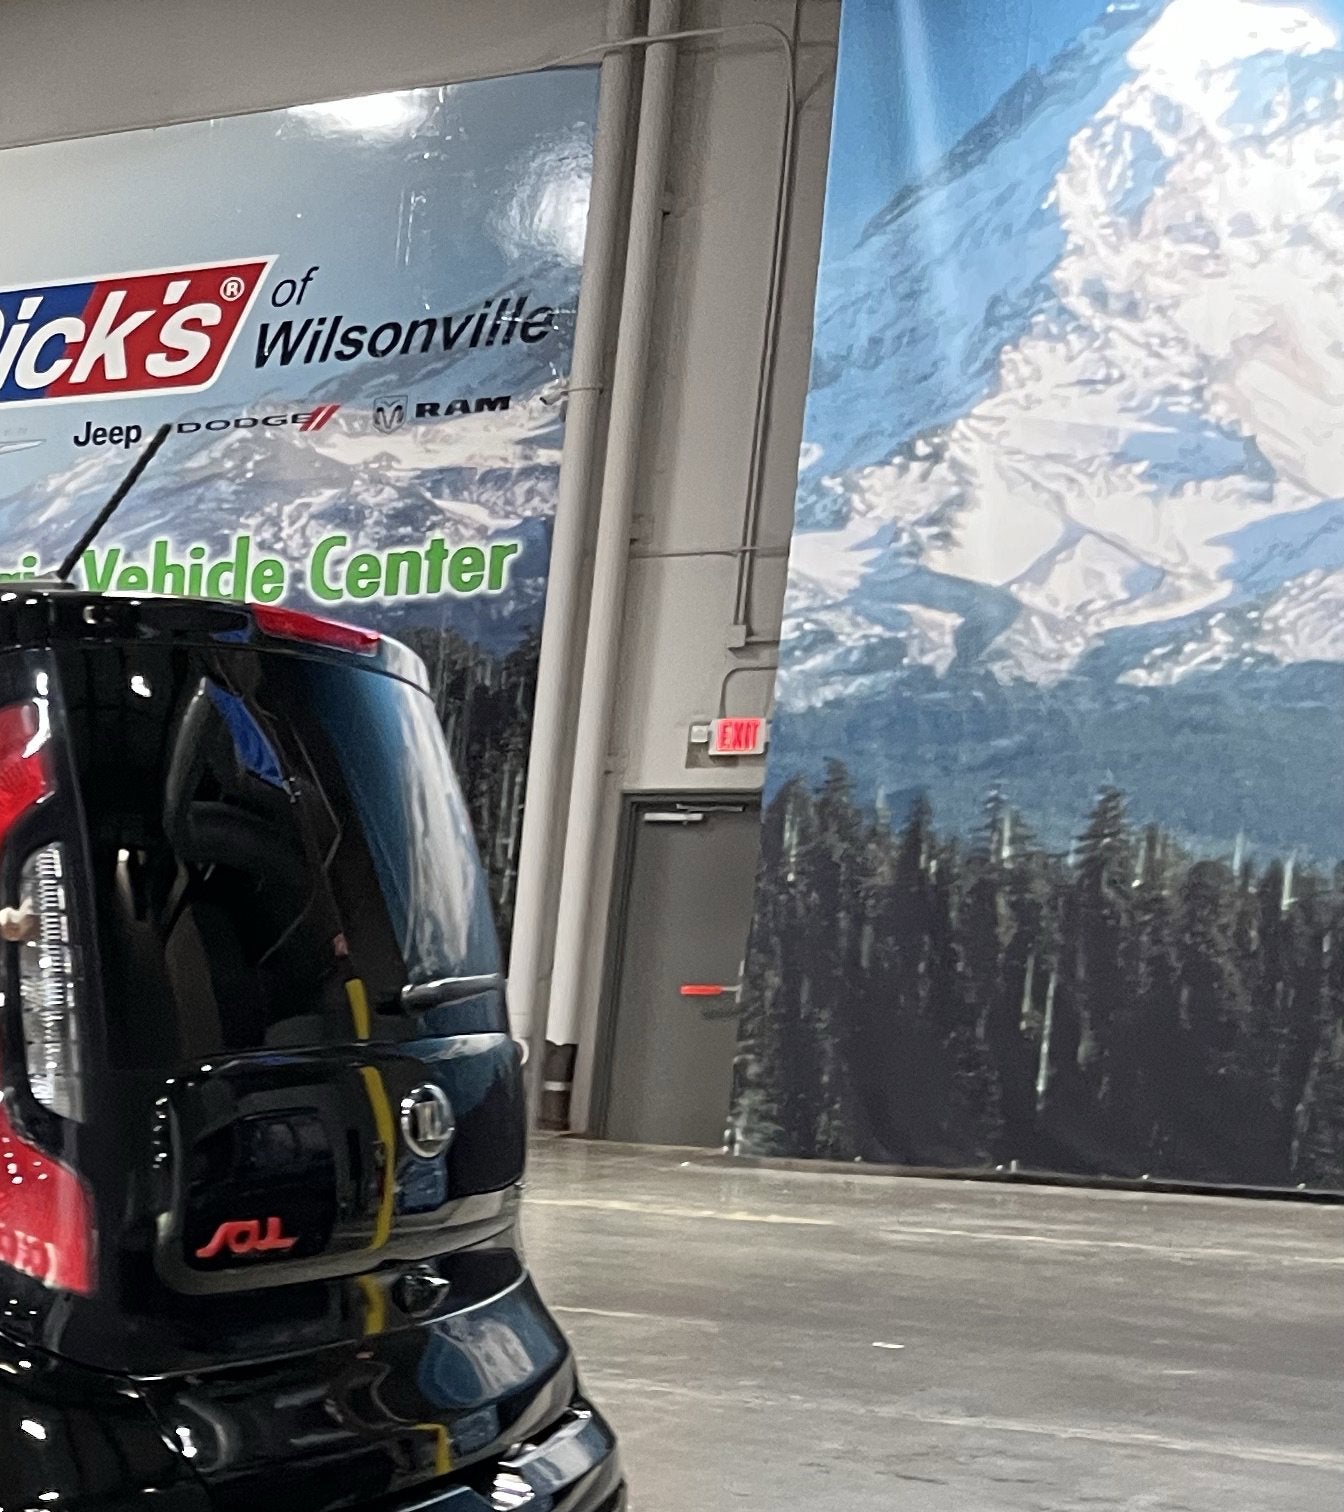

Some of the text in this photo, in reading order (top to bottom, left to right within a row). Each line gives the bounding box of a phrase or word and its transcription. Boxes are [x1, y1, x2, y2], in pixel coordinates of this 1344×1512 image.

[271, 266, 319, 308] of
[255, 296, 554, 368] Wilsonville
[415, 396, 512, 418] RAM
[73, 421, 142, 449] Jeep
[177, 412, 311, 434] DODGE
[83, 536, 285, 603] Vehicle
[311, 536, 518, 600] Center
[718, 721, 760, 750] EXIT
